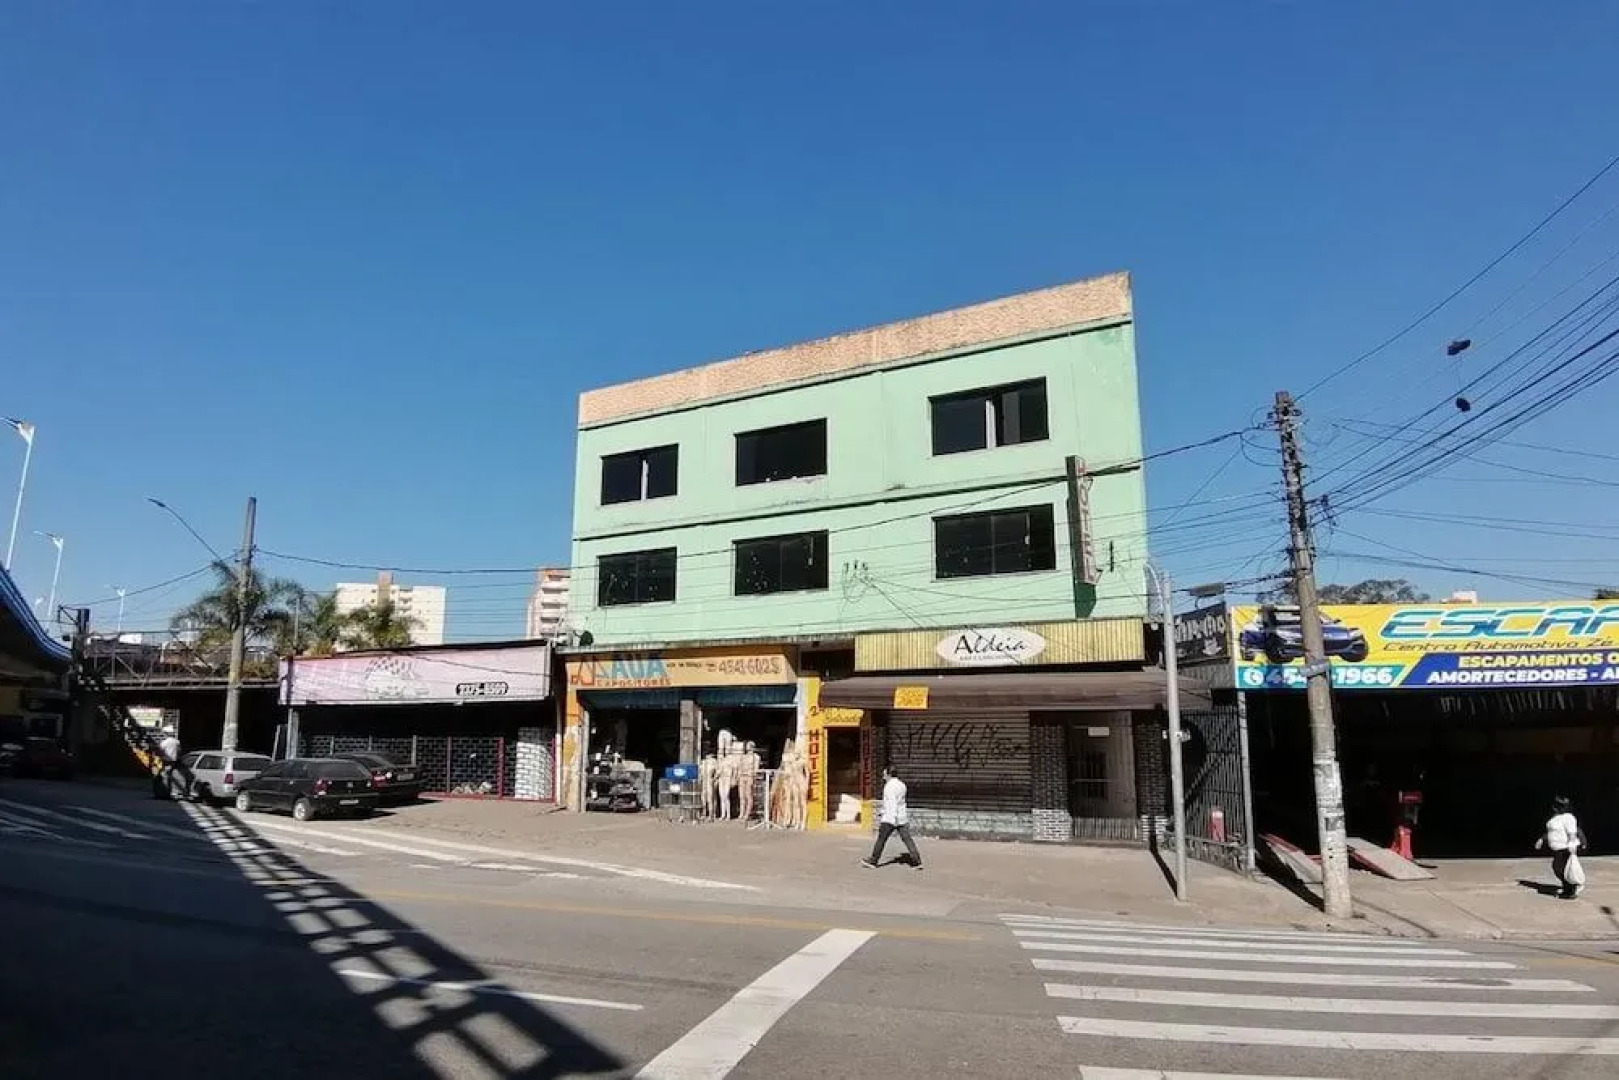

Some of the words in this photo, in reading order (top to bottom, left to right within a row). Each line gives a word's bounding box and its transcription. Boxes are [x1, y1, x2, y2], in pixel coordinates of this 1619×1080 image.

[954, 634, 1027, 654] Aldeia
[1383, 641, 1457, 652] Centro
[1463, 639, 1579, 651] Automotivo
[1458, 653, 1602, 668] ESCAPAMENTOS
[1266, 667, 1392, 685] 45-1966
[1427, 669, 1587, 684] AMORTECEDORES
[808, 729, 819, 802] HOTEL
